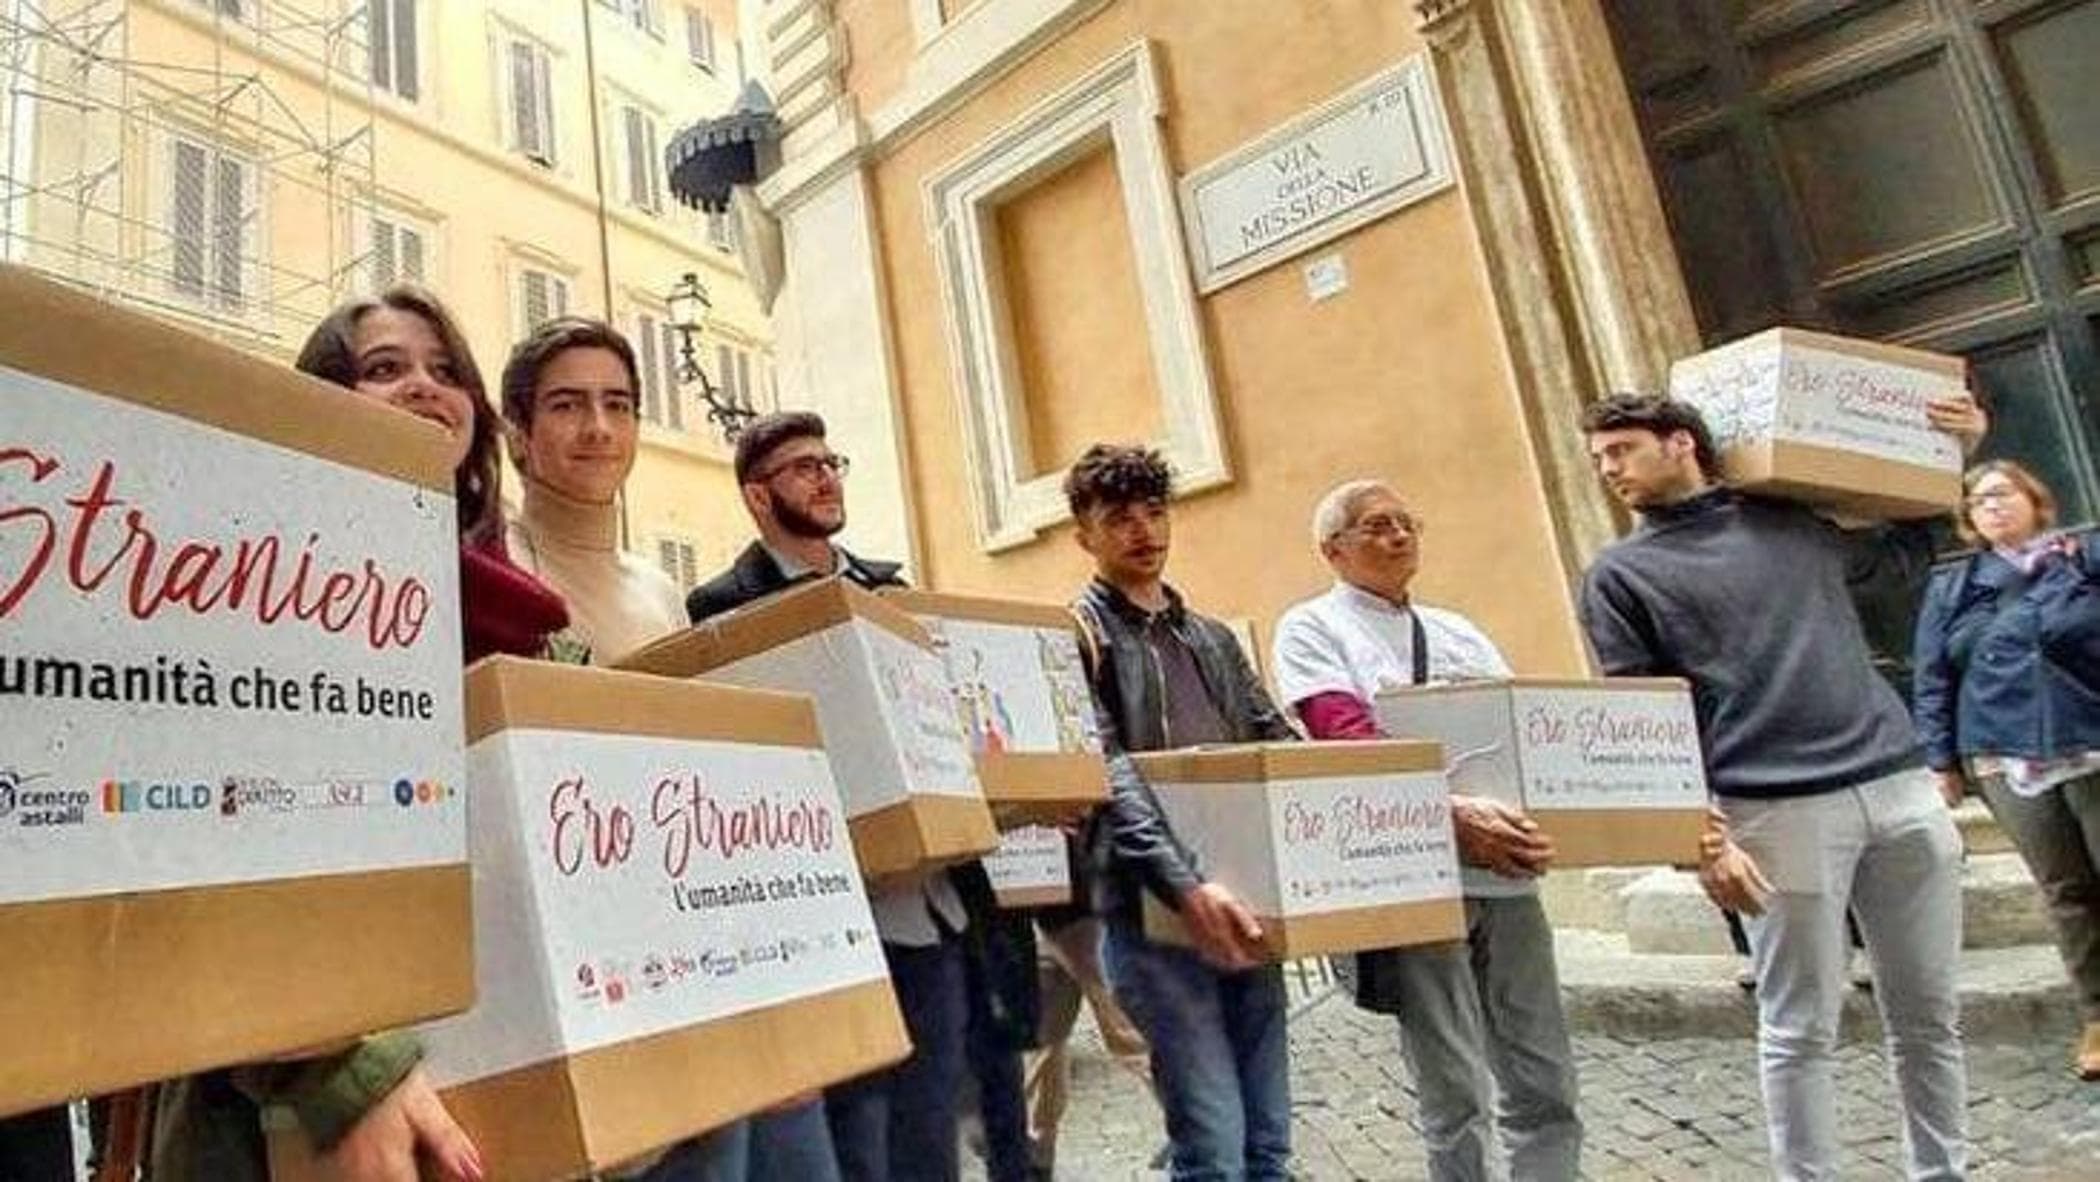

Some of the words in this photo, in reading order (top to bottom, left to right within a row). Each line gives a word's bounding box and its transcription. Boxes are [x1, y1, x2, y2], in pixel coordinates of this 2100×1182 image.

[1271, 142, 1321, 177] VIA
[1240, 165, 1377, 250] MISSIONE
[230, 667, 301, 712] che
[310, 672, 348, 714] fa
[357, 677, 434, 720] bene
[19, 789, 91, 807] centro
[145, 784, 212, 810] CILD
[19, 805, 85, 827] astalli
[550, 774, 635, 876] Ero
[651, 772, 834, 880] Straniero
[1284, 799, 1325, 846] Ero
[768, 873, 796, 901] che
